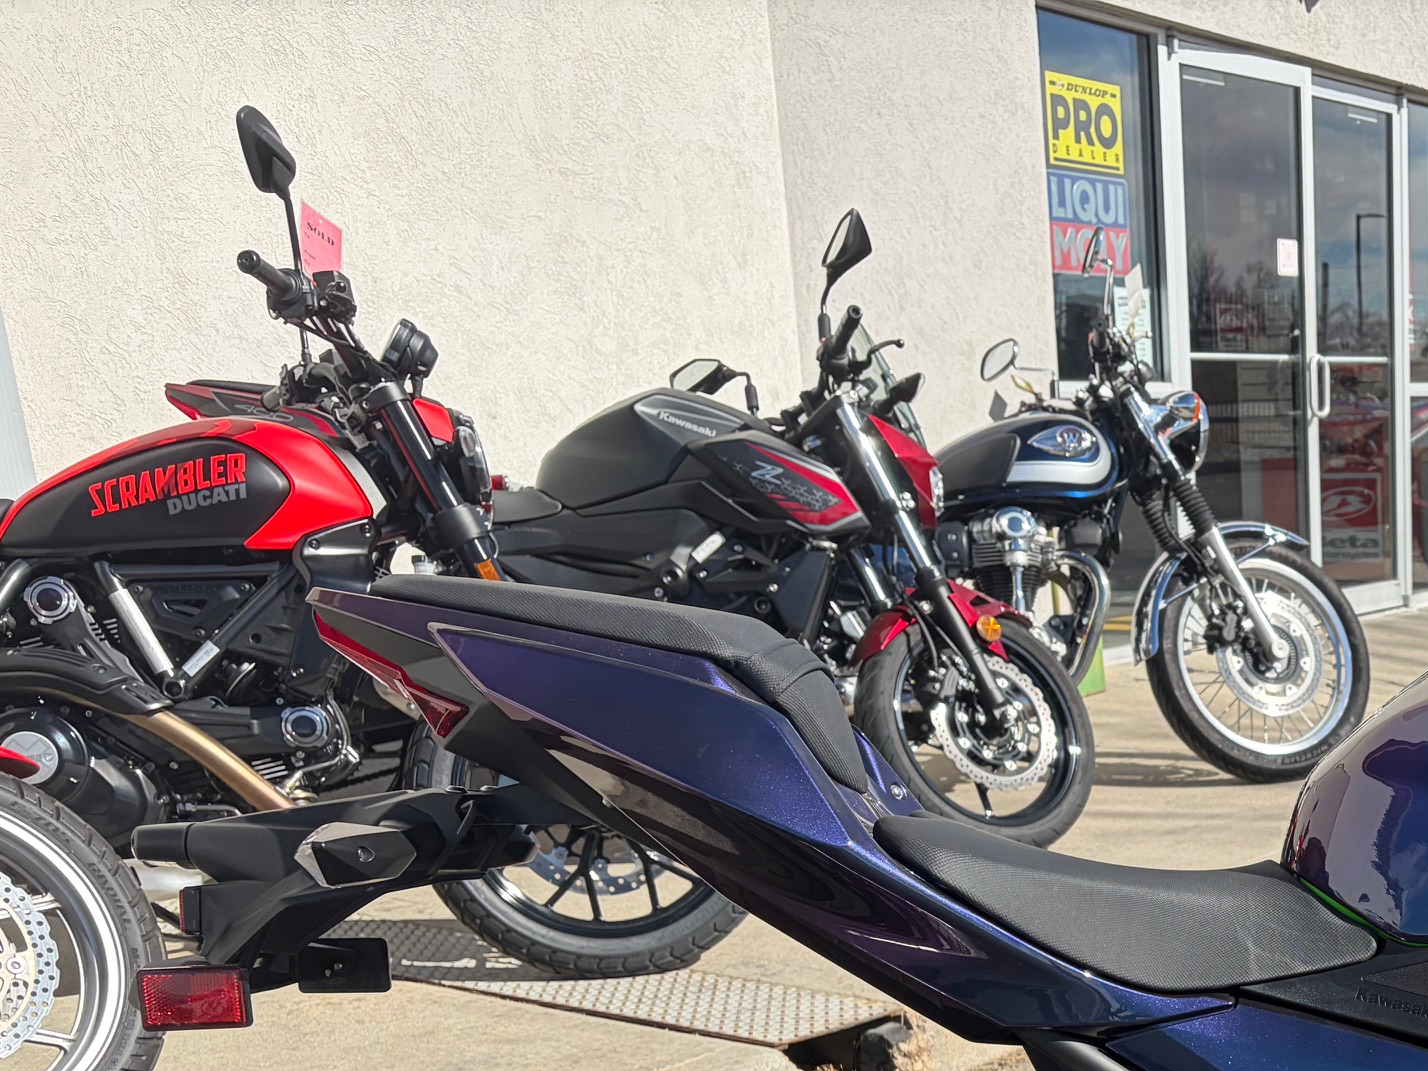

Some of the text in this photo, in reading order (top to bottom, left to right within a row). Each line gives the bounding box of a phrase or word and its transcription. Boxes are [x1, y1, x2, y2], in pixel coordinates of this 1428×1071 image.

[1065, 83, 1108, 98] DUNLOP
[1050, 93, 1118, 150] PRO
[1052, 143, 1120, 163] DEALER
[1049, 175, 1125, 225] LIQUI
[307, 222, 335, 246] SOLD
[658, 411, 717, 438] Kawasaki
[1063, 432, 1079, 447] W
[88, 452, 247, 516] SCRAMBLER
[166, 482, 247, 515] DUCATI
[1322, 534, 1379, 549] eta
